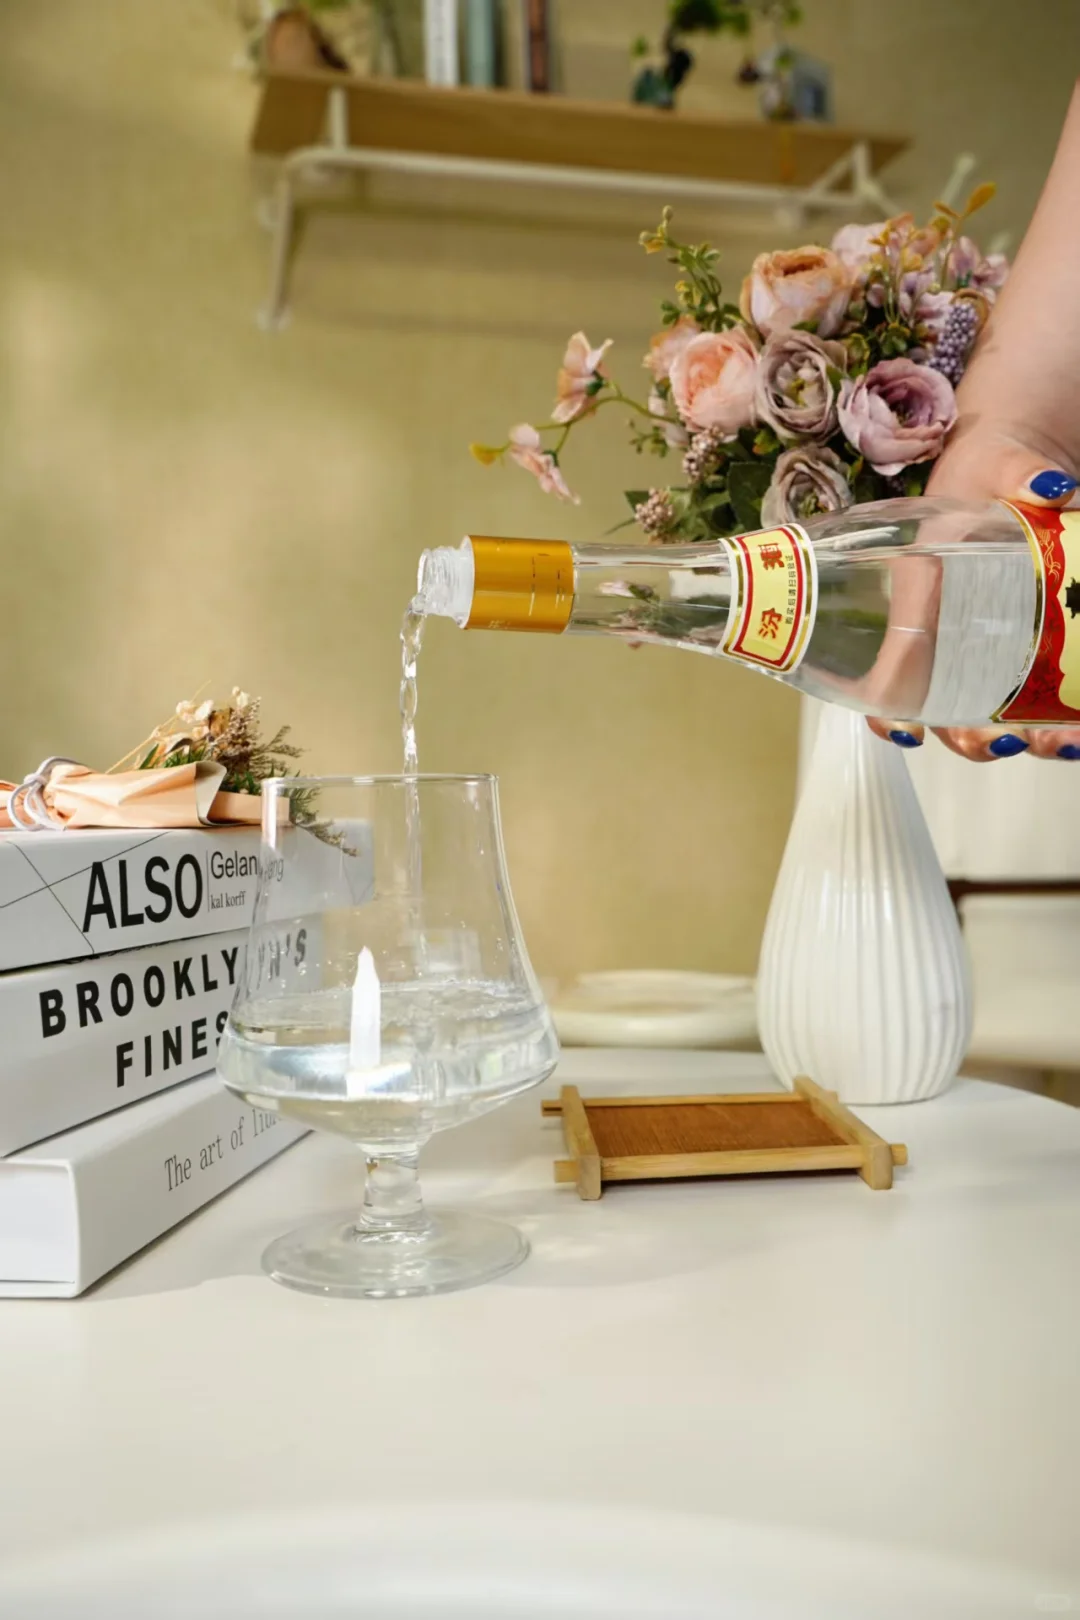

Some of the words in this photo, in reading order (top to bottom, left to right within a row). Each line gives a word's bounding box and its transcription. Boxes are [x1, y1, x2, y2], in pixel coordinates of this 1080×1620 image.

[82, 853, 203, 932] ALSO
[210, 893, 224, 909] kal
[226, 890, 246, 907] korff
[164, 1154, 192, 1192] The
[199, 1135, 224, 1170] art
[230, 1116, 245, 1150] of
